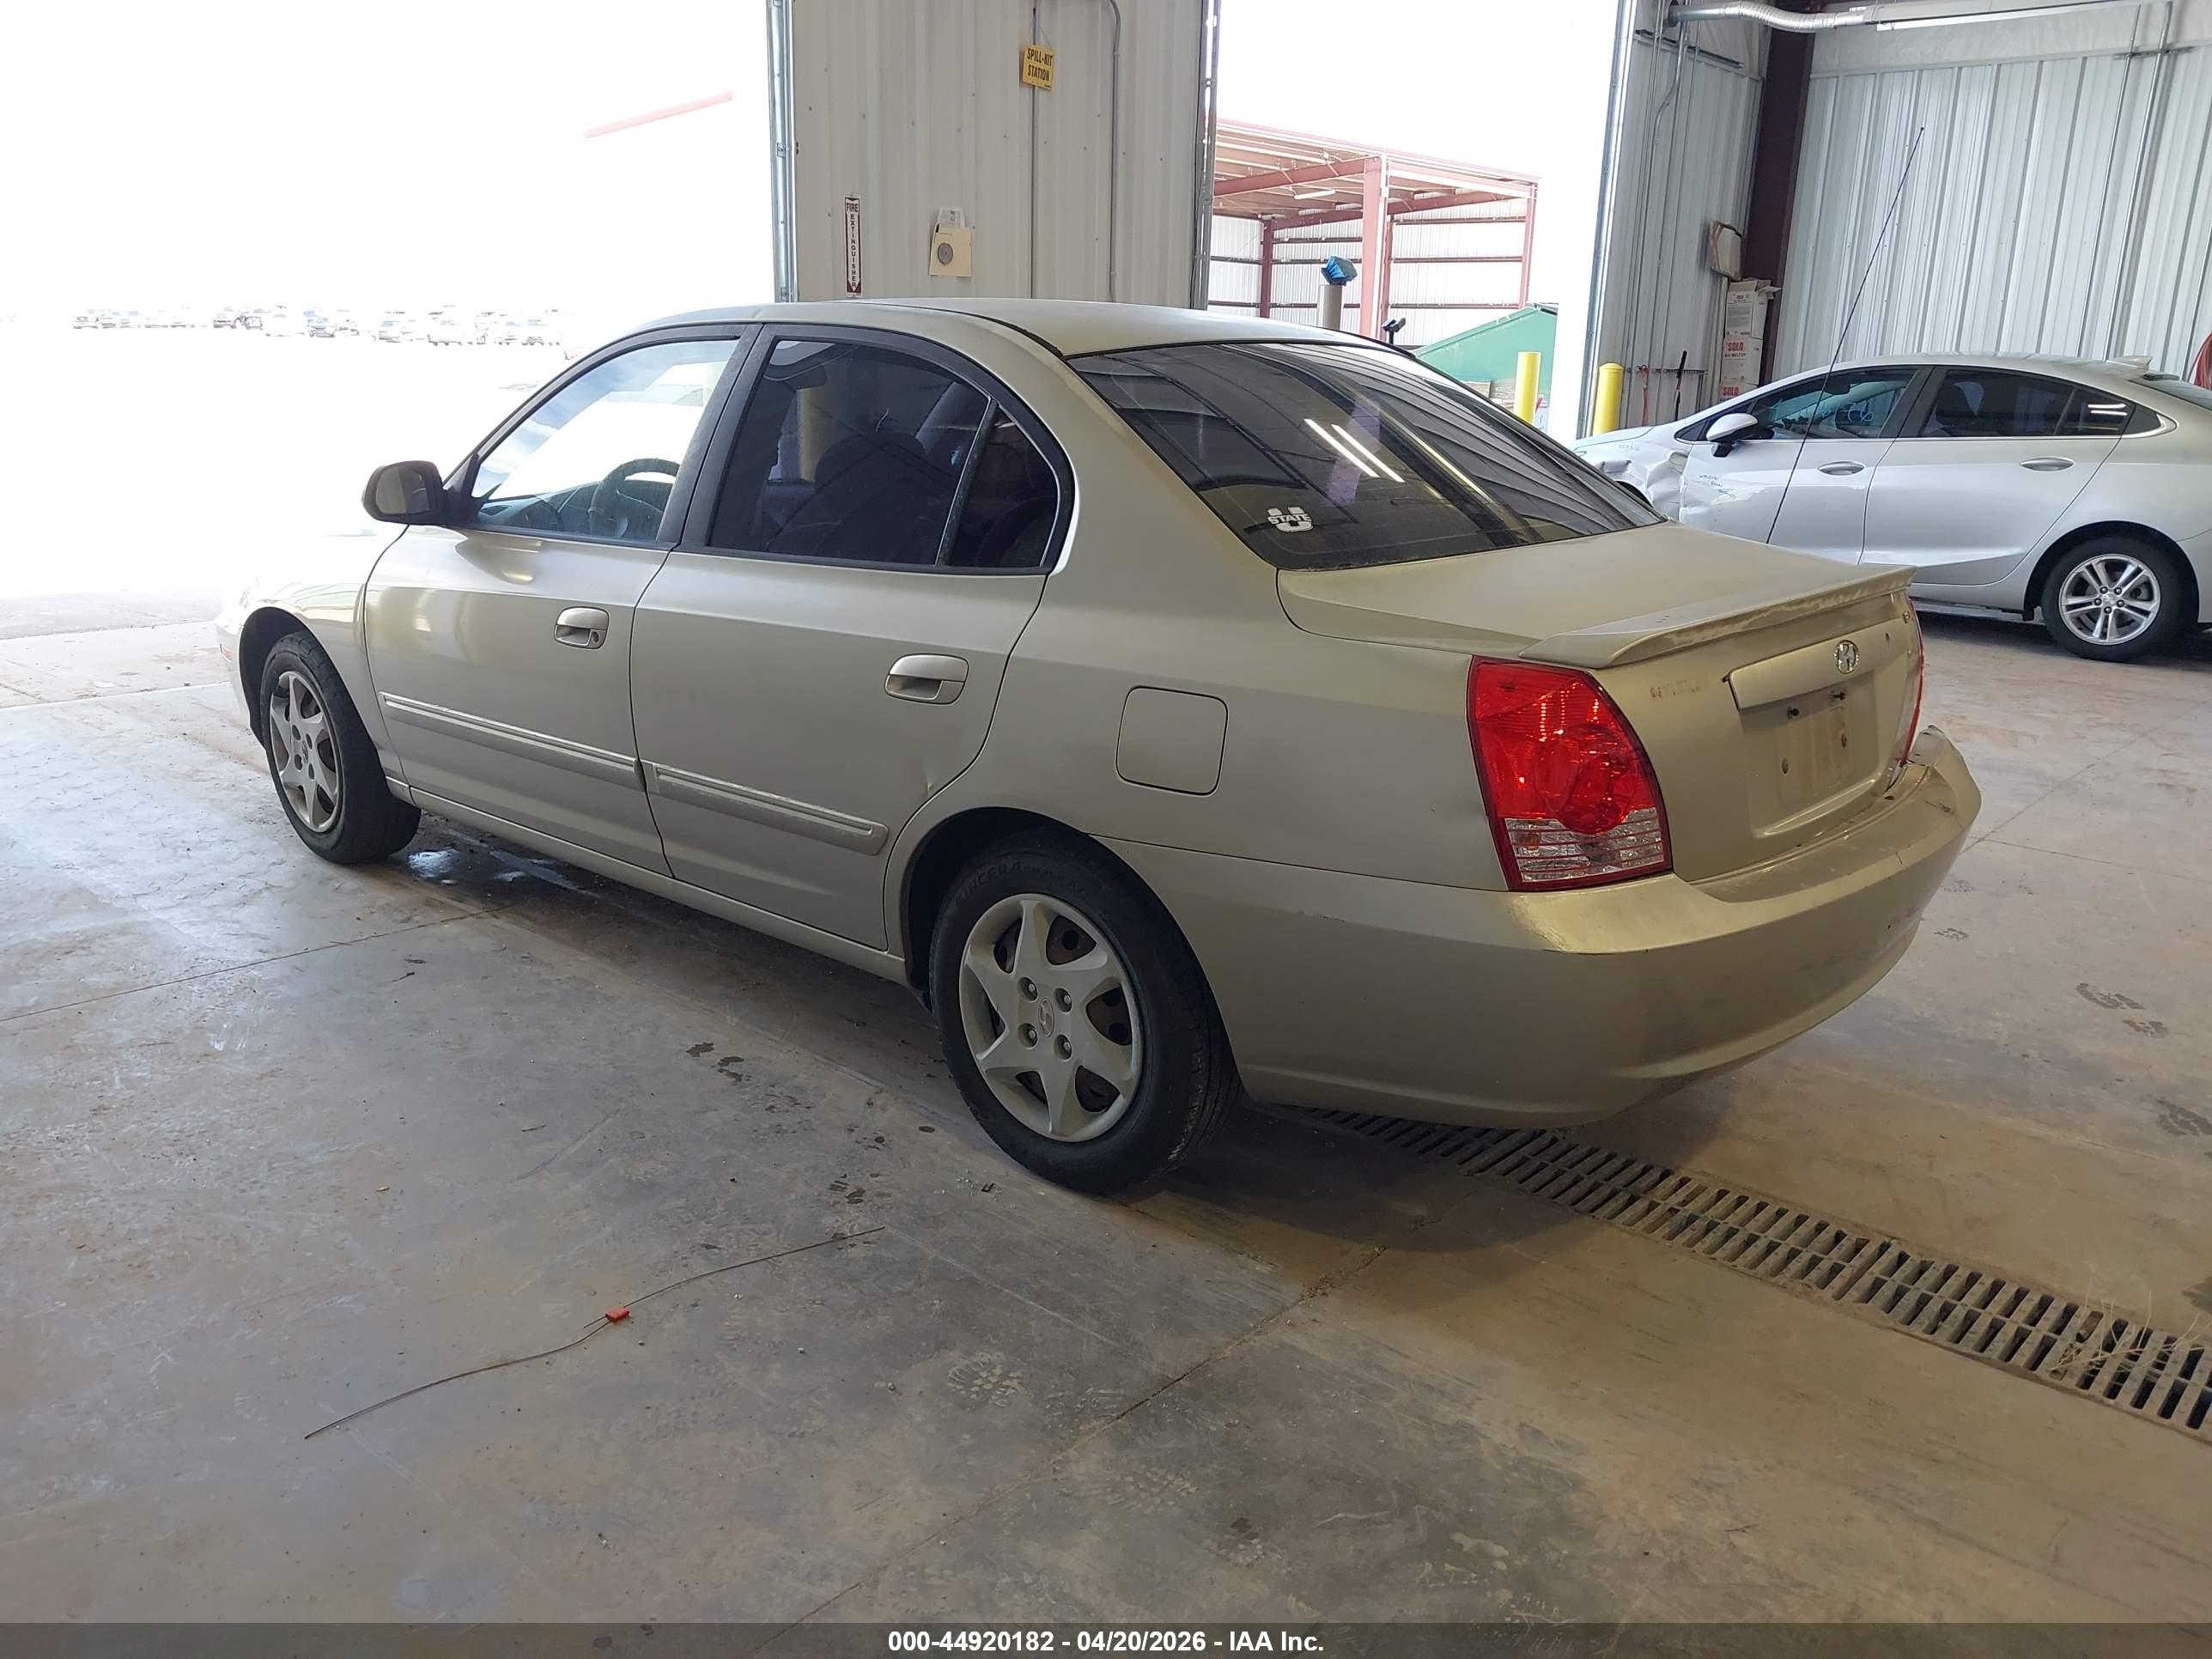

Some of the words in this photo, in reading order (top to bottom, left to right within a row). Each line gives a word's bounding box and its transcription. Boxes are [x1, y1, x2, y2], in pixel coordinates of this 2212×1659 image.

[1027, 64, 1050, 82] STATION
[847, 203, 859, 213] FIRE
[1729, 342, 1744, 352] SOLO
[1267, 514, 1312, 525] STATE
